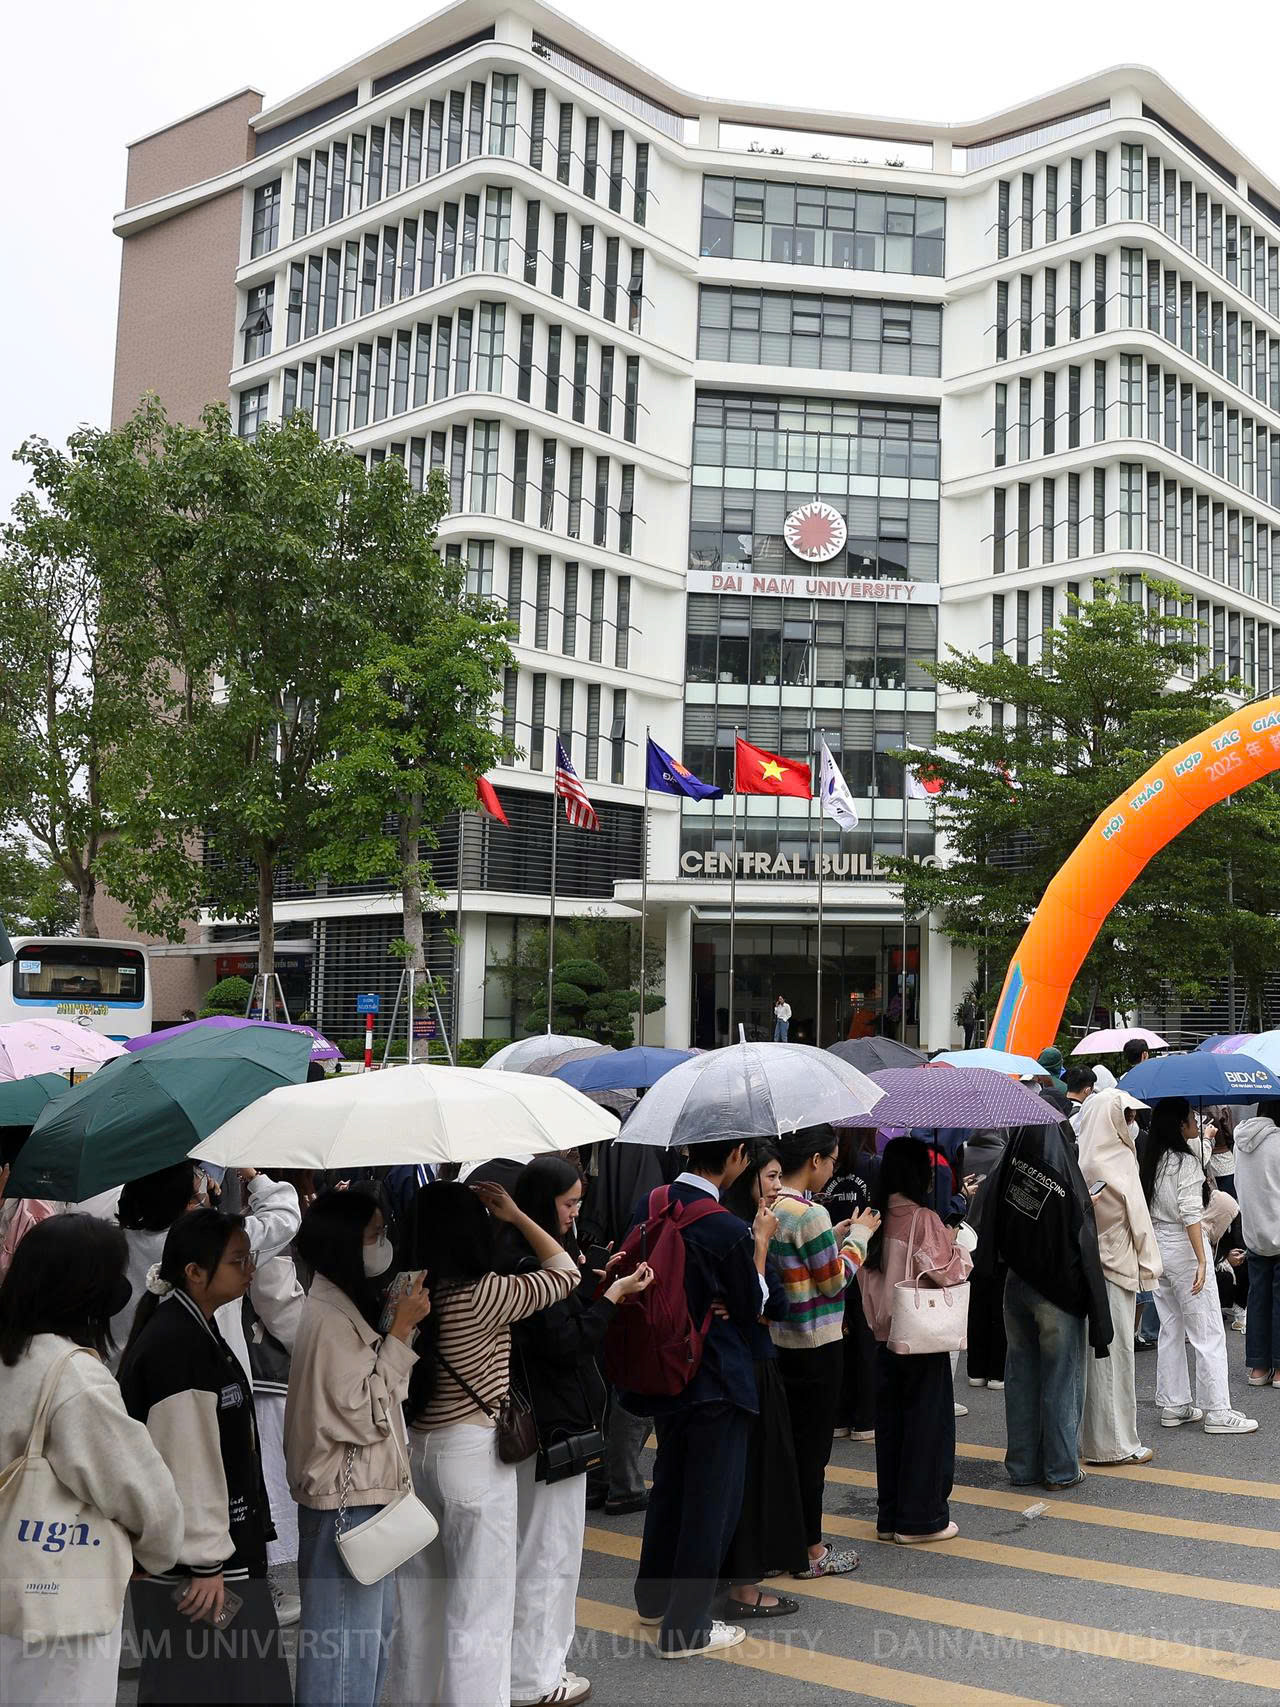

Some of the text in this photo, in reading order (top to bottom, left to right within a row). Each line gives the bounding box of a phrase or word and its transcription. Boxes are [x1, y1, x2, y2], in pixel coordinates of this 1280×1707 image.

[753, 577, 795, 594] NAM
[806, 580, 916, 600] UNIVERSITY
[1103, 815, 1124, 840] HỘI
[1130, 779, 1164, 811] THẢO
[1174, 751, 1202, 777] HỢP
[1212, 729, 1240, 752] TÁC
[680, 850, 805, 874] CENTRAL
[1224, 1071, 1256, 1083] BIDV
